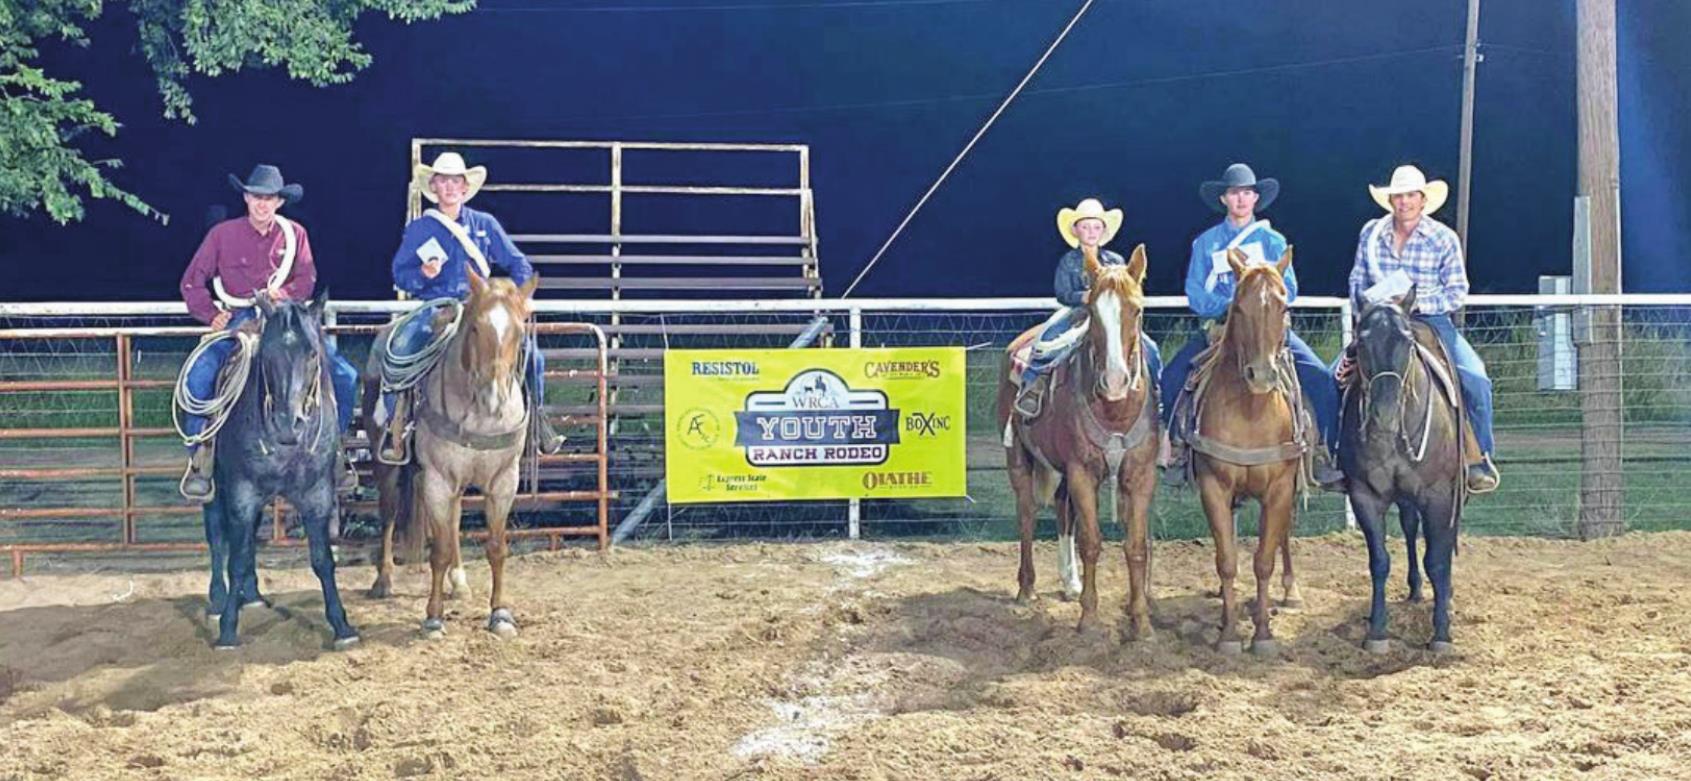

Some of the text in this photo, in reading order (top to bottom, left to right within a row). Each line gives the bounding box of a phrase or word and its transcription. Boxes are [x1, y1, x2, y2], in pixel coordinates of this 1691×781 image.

[692, 362, 759, 375] RESISTOL
[864, 360, 940, 378] CAVENDER'S
[792, 396, 839, 409] WRCA
[756, 416, 877, 440] YOUTH
[753, 447, 882, 460] RANCH RODEO
